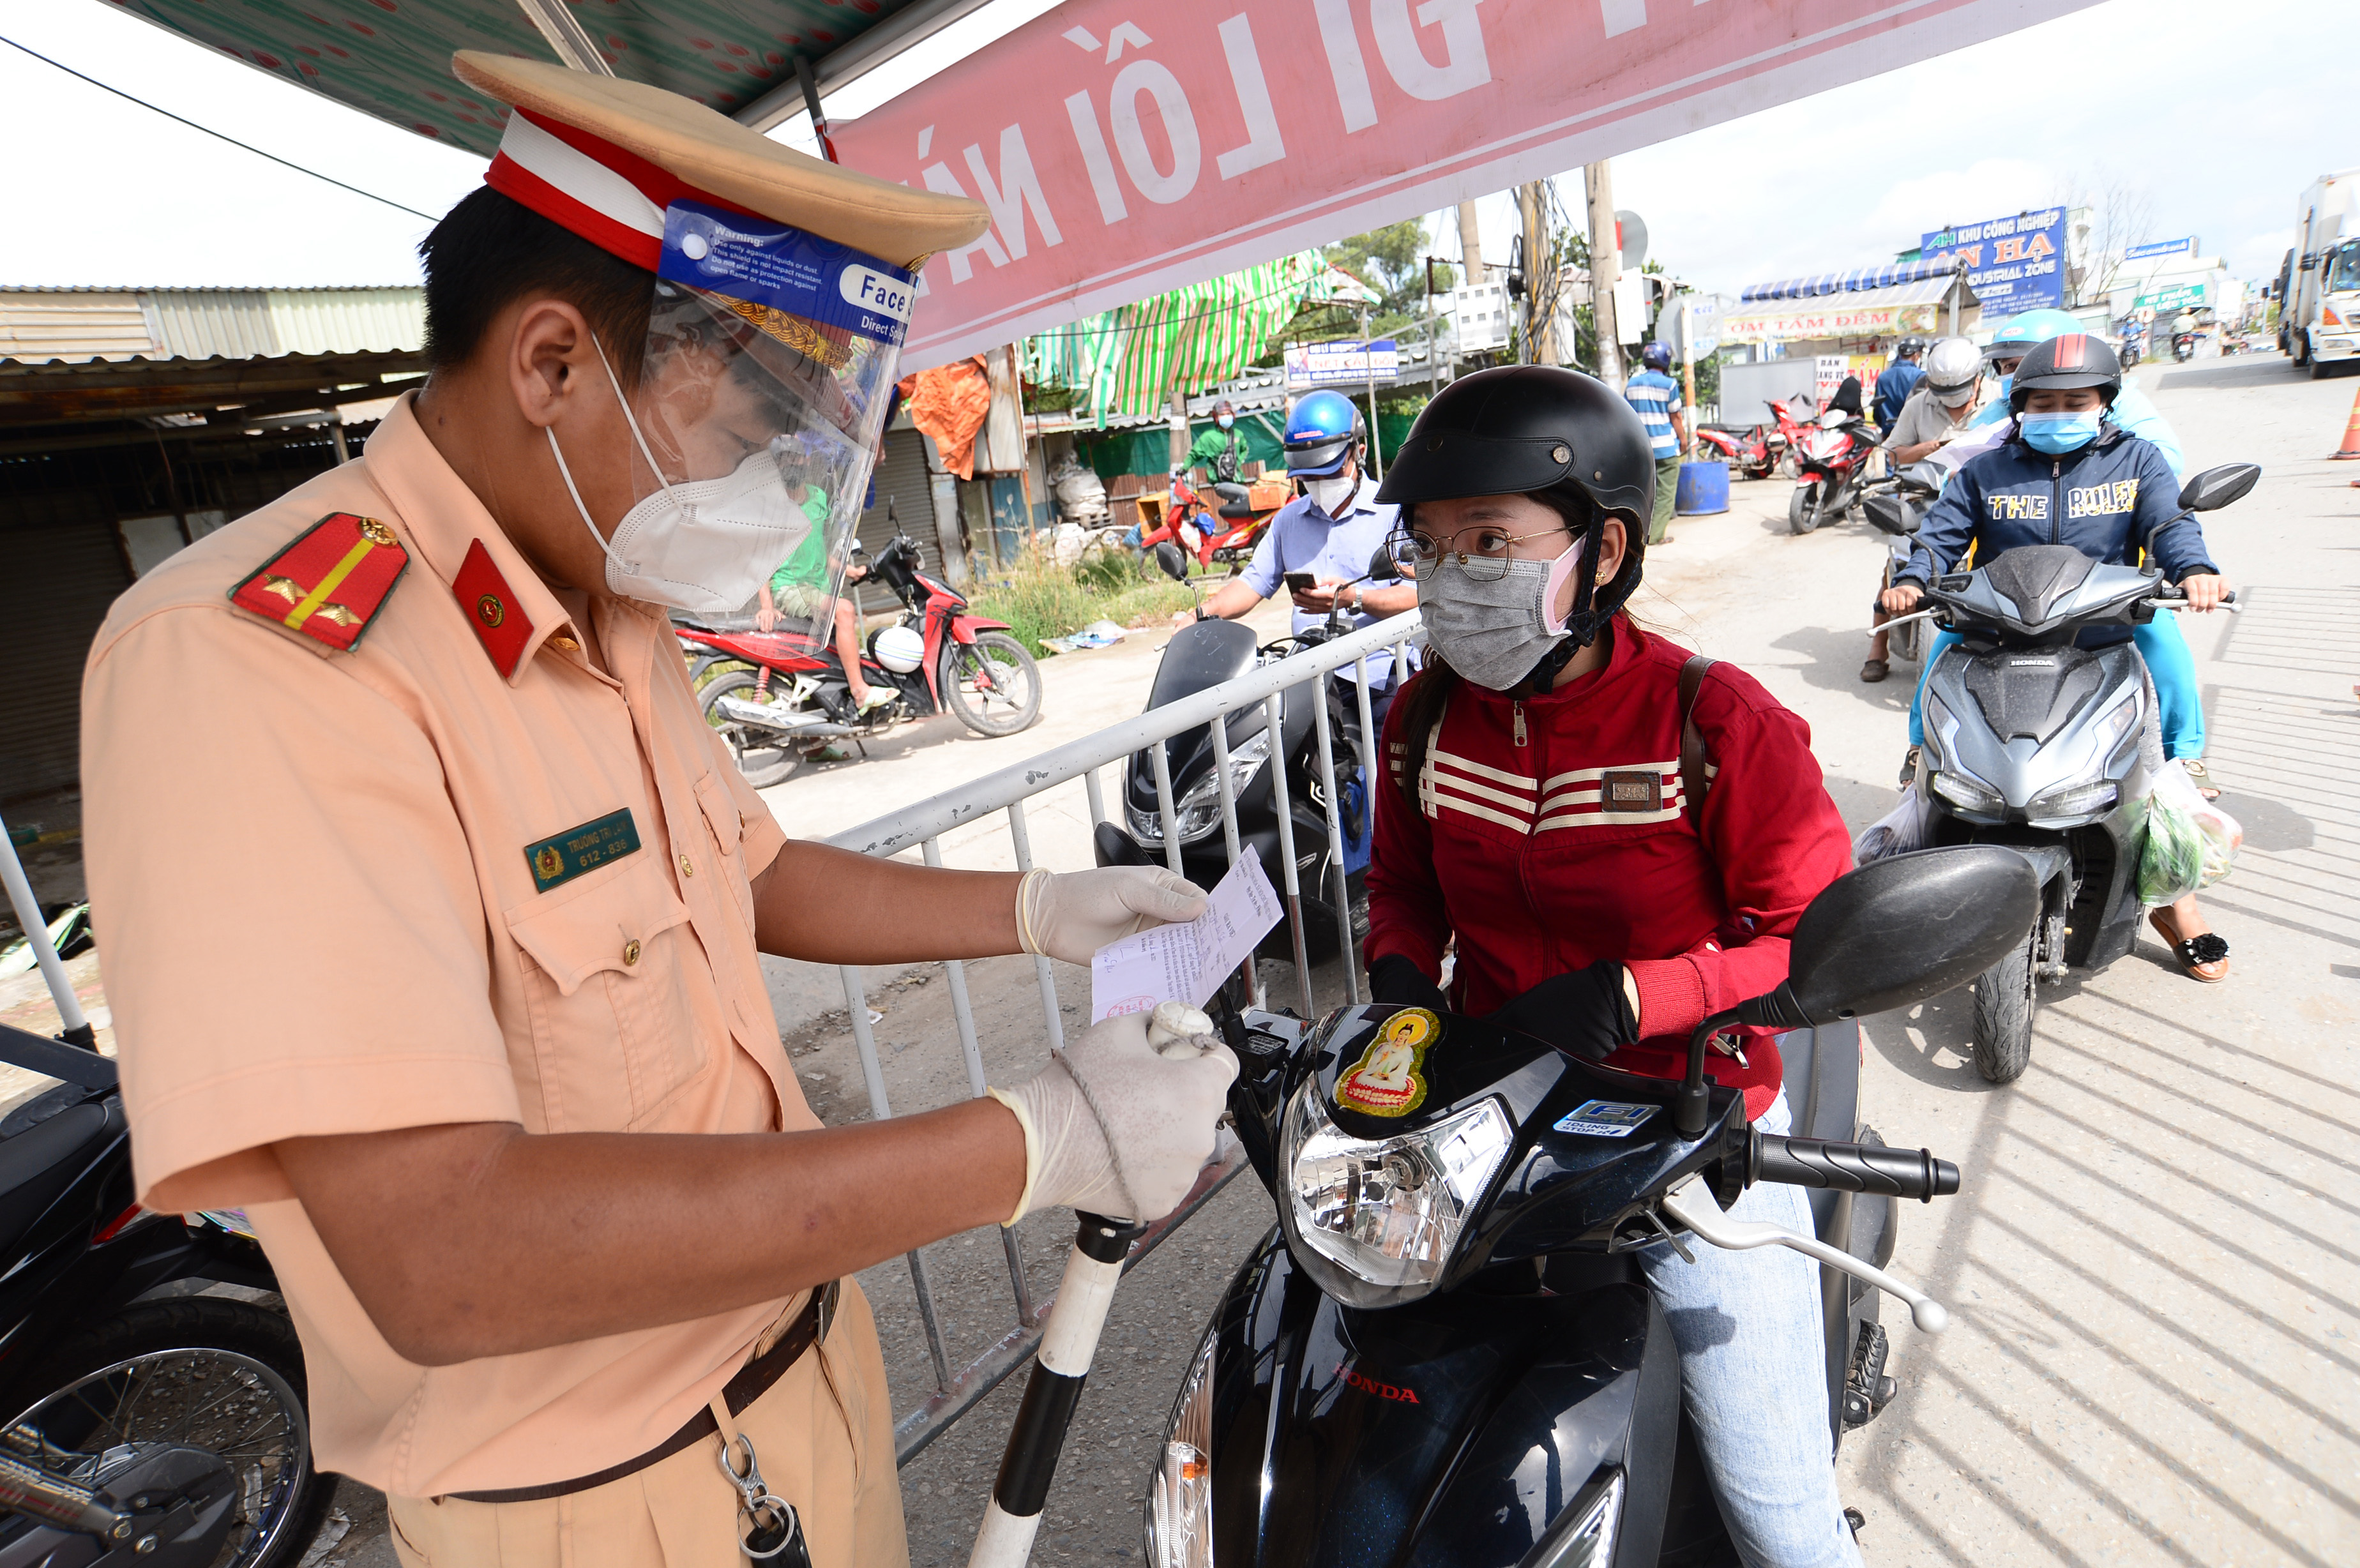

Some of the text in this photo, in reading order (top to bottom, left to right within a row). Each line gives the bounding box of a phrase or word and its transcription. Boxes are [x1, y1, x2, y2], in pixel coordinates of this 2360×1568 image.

[715, 225, 764, 247] Warning:
[1958, 225, 1981, 245] KHU
[1983, 220, 2016, 240] CÔNG
[2016, 211, 2060, 234] NGHIỆP
[714, 239, 727, 248] Use
[729, 242, 745, 253] only
[746, 248, 771, 260] against
[773, 255, 794, 267] liquids
[1993, 232, 2055, 263] HẠ
[710, 264, 728, 275] open
[729, 270, 748, 280] flame
[758, 279, 780, 290] sparks
[711, 255, 722, 264] Do
[723, 259, 736, 268] not
[736, 263, 749, 271] use
[759, 269, 793, 284] protection
[794, 280, 817, 292] against
[713, 248, 728, 257] This
[730, 252, 751, 263] shield
[760, 260, 771, 269] not
[773, 263, 794, 276] impact
[795, 271, 823, 285] resistant.
[1966, 259, 2056, 287] NDUSTRIAL ZONE
[861, 274, 905, 312] Face
[861, 315, 888, 335] Direct
[1724, 320, 1764, 333] ƠM
[1988, 495, 2048, 520] THE
[579, 850, 601, 866] 612
[608, 839, 627, 854] 836
[1585, 1104, 1650, 1119] FI
[1332, 1361, 1420, 1404] HONDA
